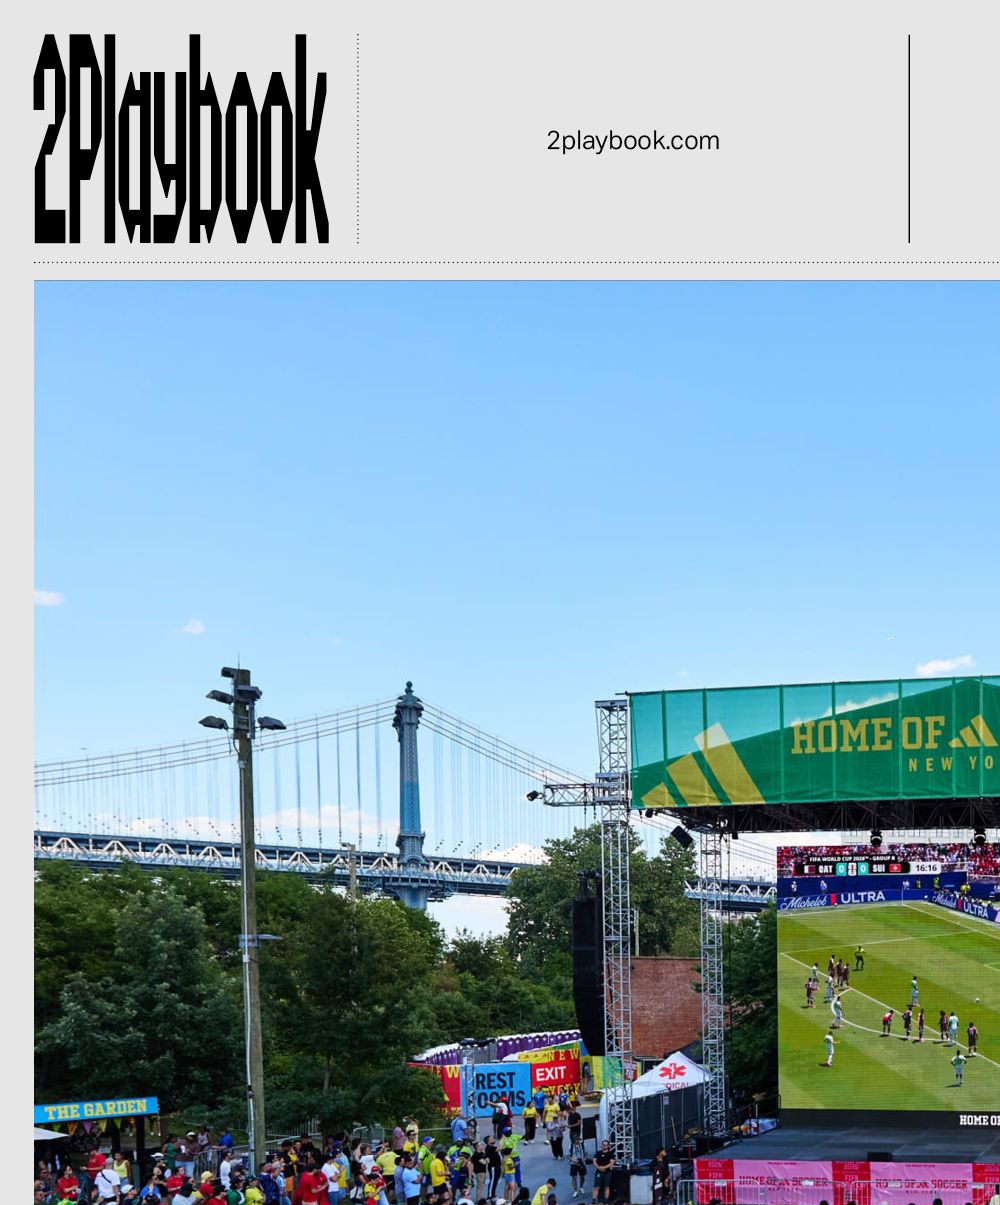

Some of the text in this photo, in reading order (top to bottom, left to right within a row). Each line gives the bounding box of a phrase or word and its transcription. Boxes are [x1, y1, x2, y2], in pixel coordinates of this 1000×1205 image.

[791, 718, 893, 754] HOME
[902, 716, 945, 749] OF
[908, 757, 953, 772] NEW
[818, 865, 833, 874] QAT
[872, 864, 886, 873] SUI
[915, 864, 938, 872] 16:16
[780, 891, 886, 910] Michelob ULTRA
[963, 902, 989, 919] ULTRA
[476, 1072, 516, 1090] REST
[535, 1065, 567, 1082] EXIT
[476, 1089, 526, 1110] OOMS
[44, 1098, 148, 1120] THE GARDEN
[959, 1114, 989, 1126] HOME
